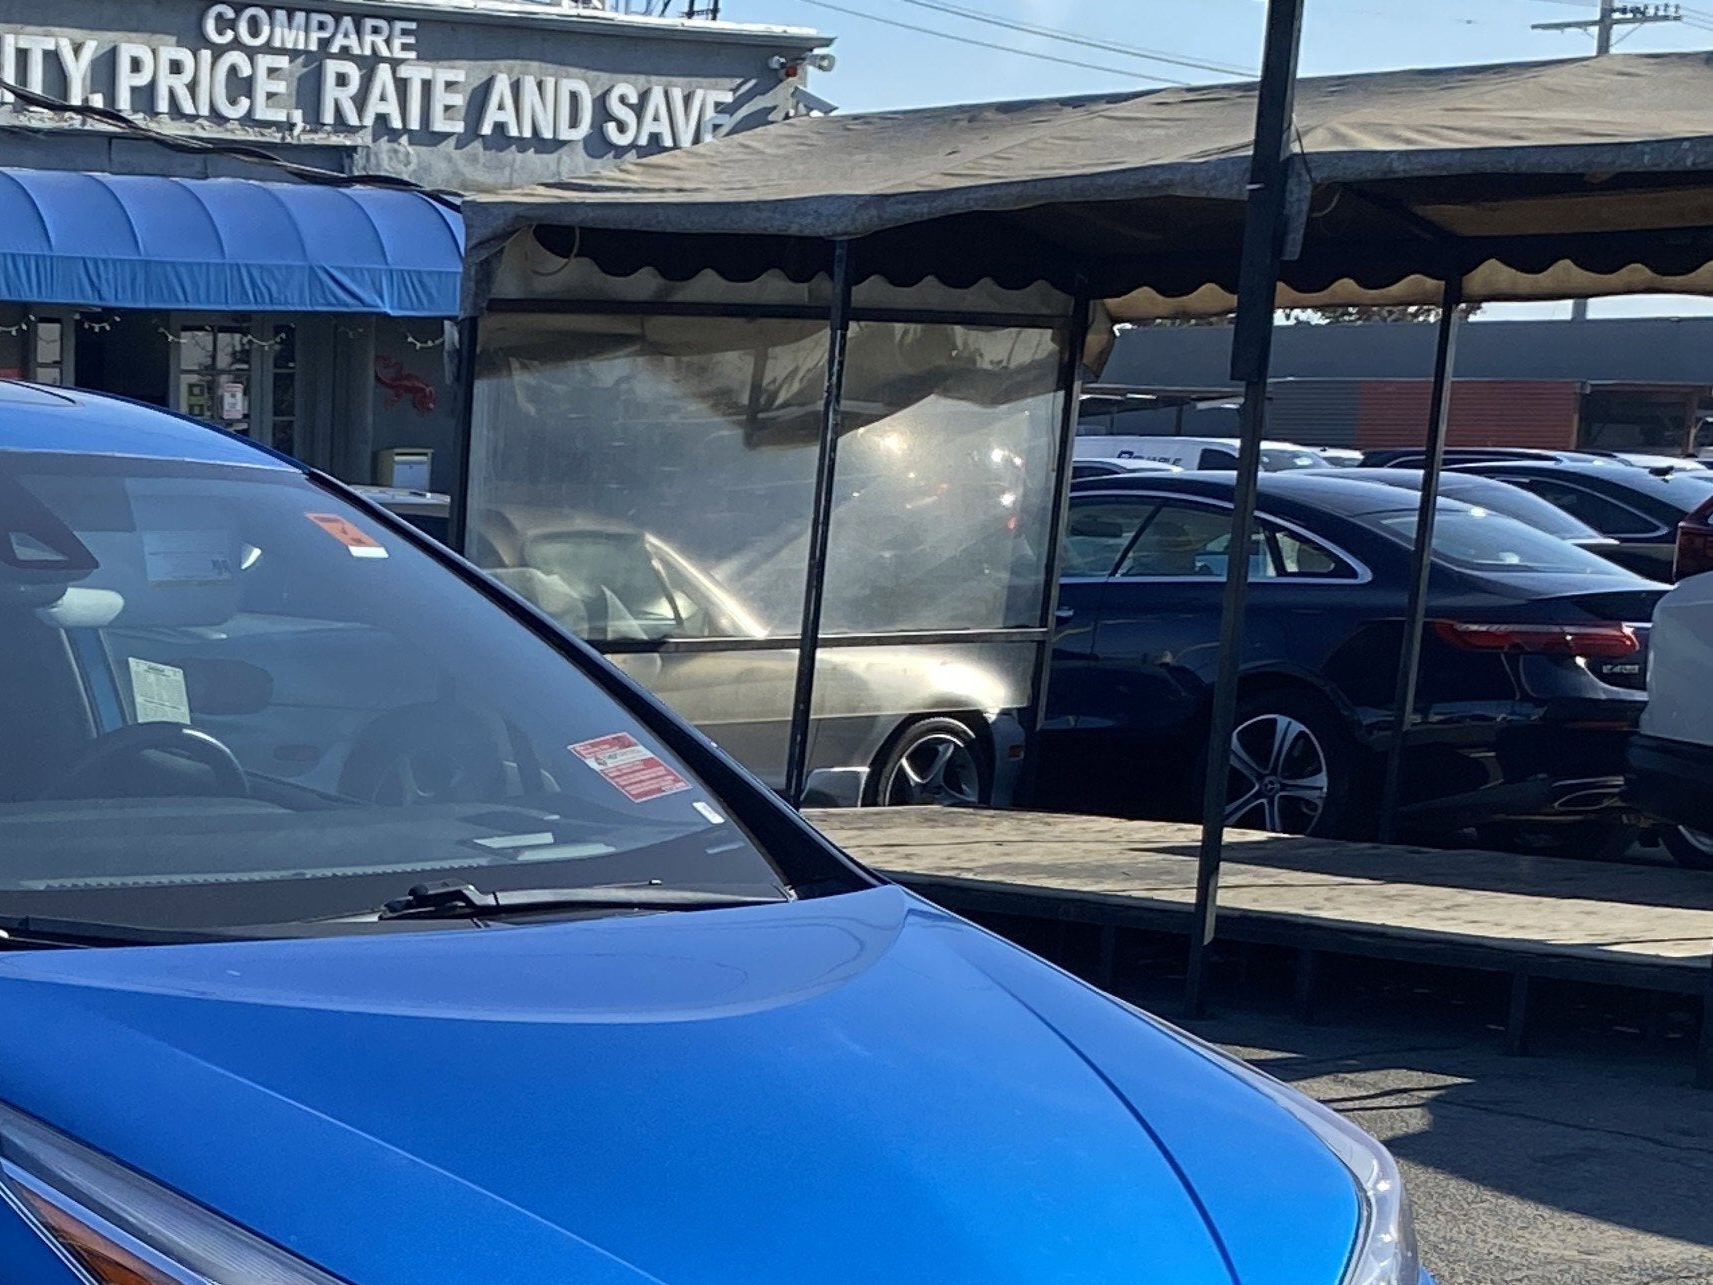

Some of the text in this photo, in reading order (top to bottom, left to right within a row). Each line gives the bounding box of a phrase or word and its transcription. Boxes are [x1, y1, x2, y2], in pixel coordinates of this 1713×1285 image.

[203, 4, 418, 59] COMPARE
[115, 42, 304, 136] PRICE,
[320, 58, 466, 133] RATE
[478, 73, 593, 142] AND
[603, 82, 734, 148] SAVE
